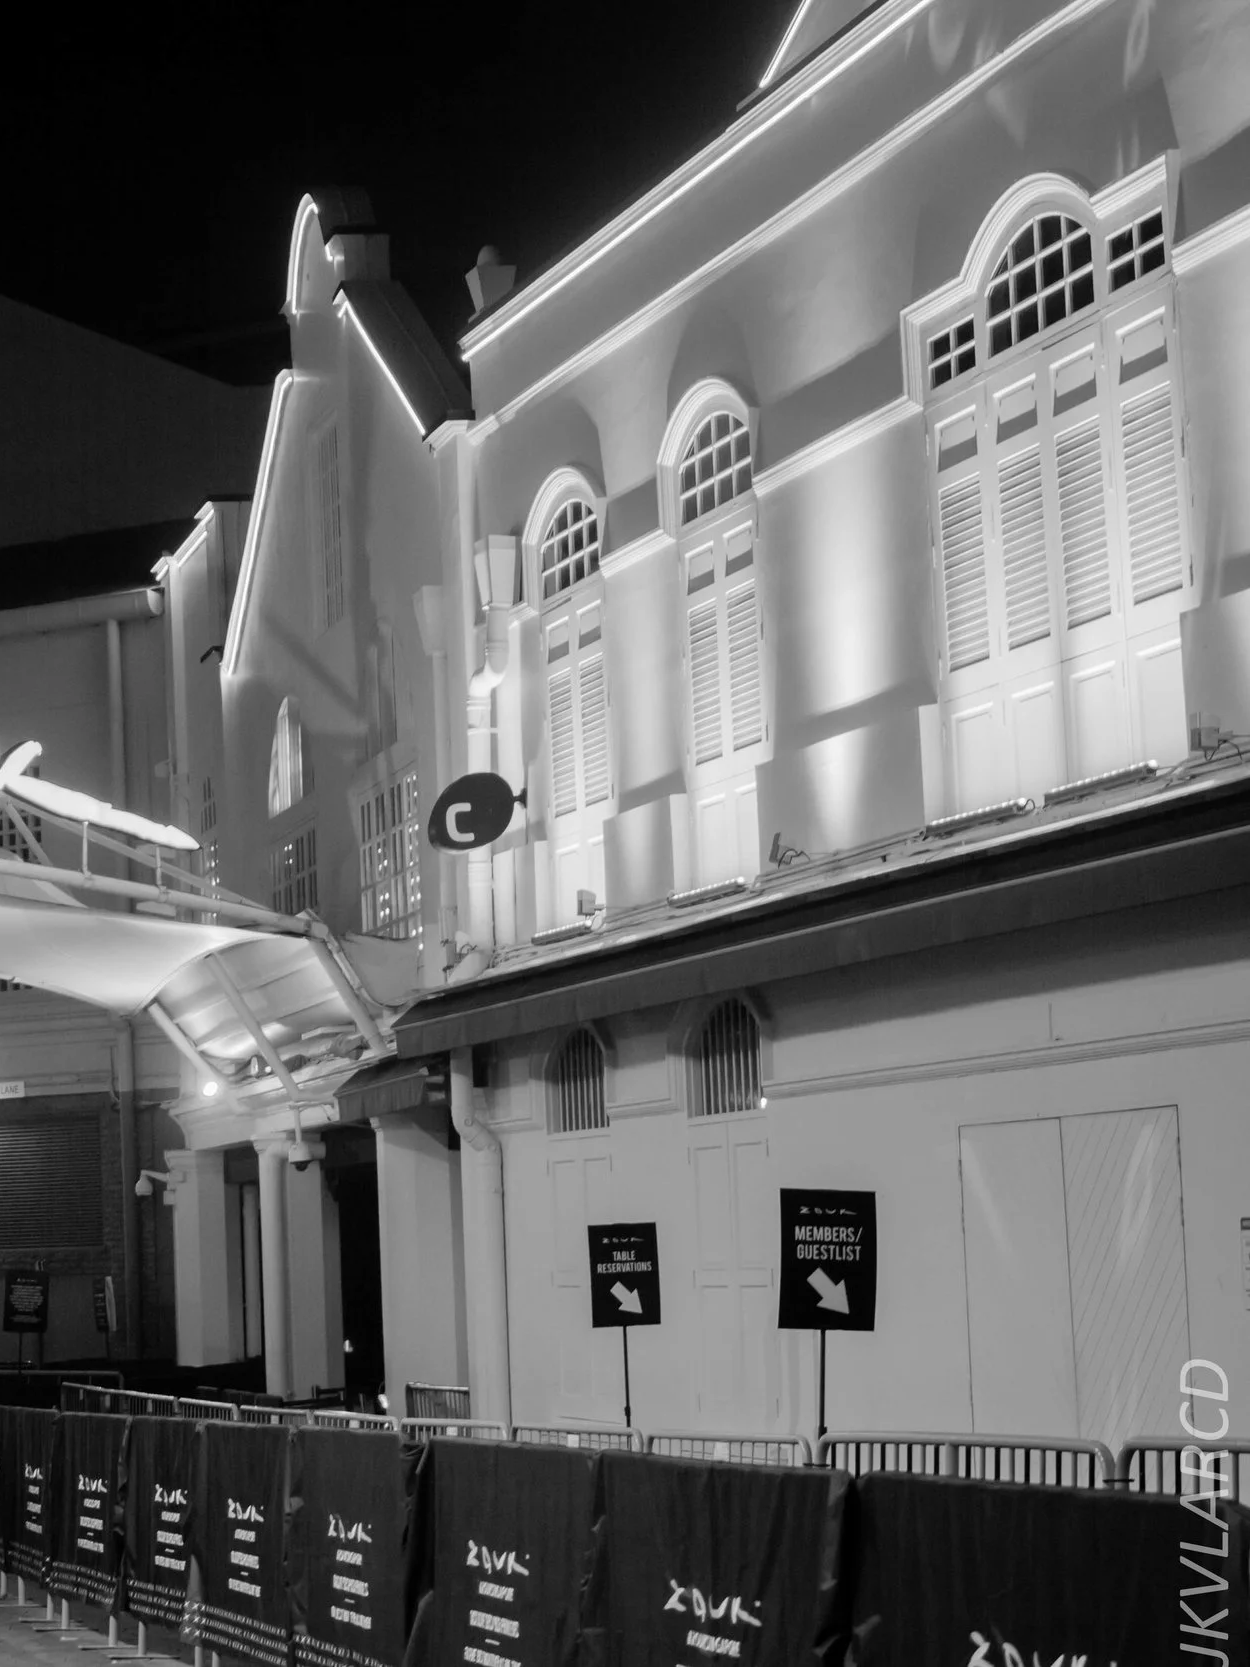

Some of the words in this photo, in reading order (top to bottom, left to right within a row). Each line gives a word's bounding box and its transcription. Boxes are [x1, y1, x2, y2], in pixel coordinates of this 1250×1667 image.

[0, 1084, 19, 1095] LANE
[794, 1225, 863, 1243] MEMBERS/
[612, 1250, 636, 1262] TABLE
[796, 1244, 861, 1261] GUESTLIST
[597, 1260, 652, 1274] RESERVATIONS
